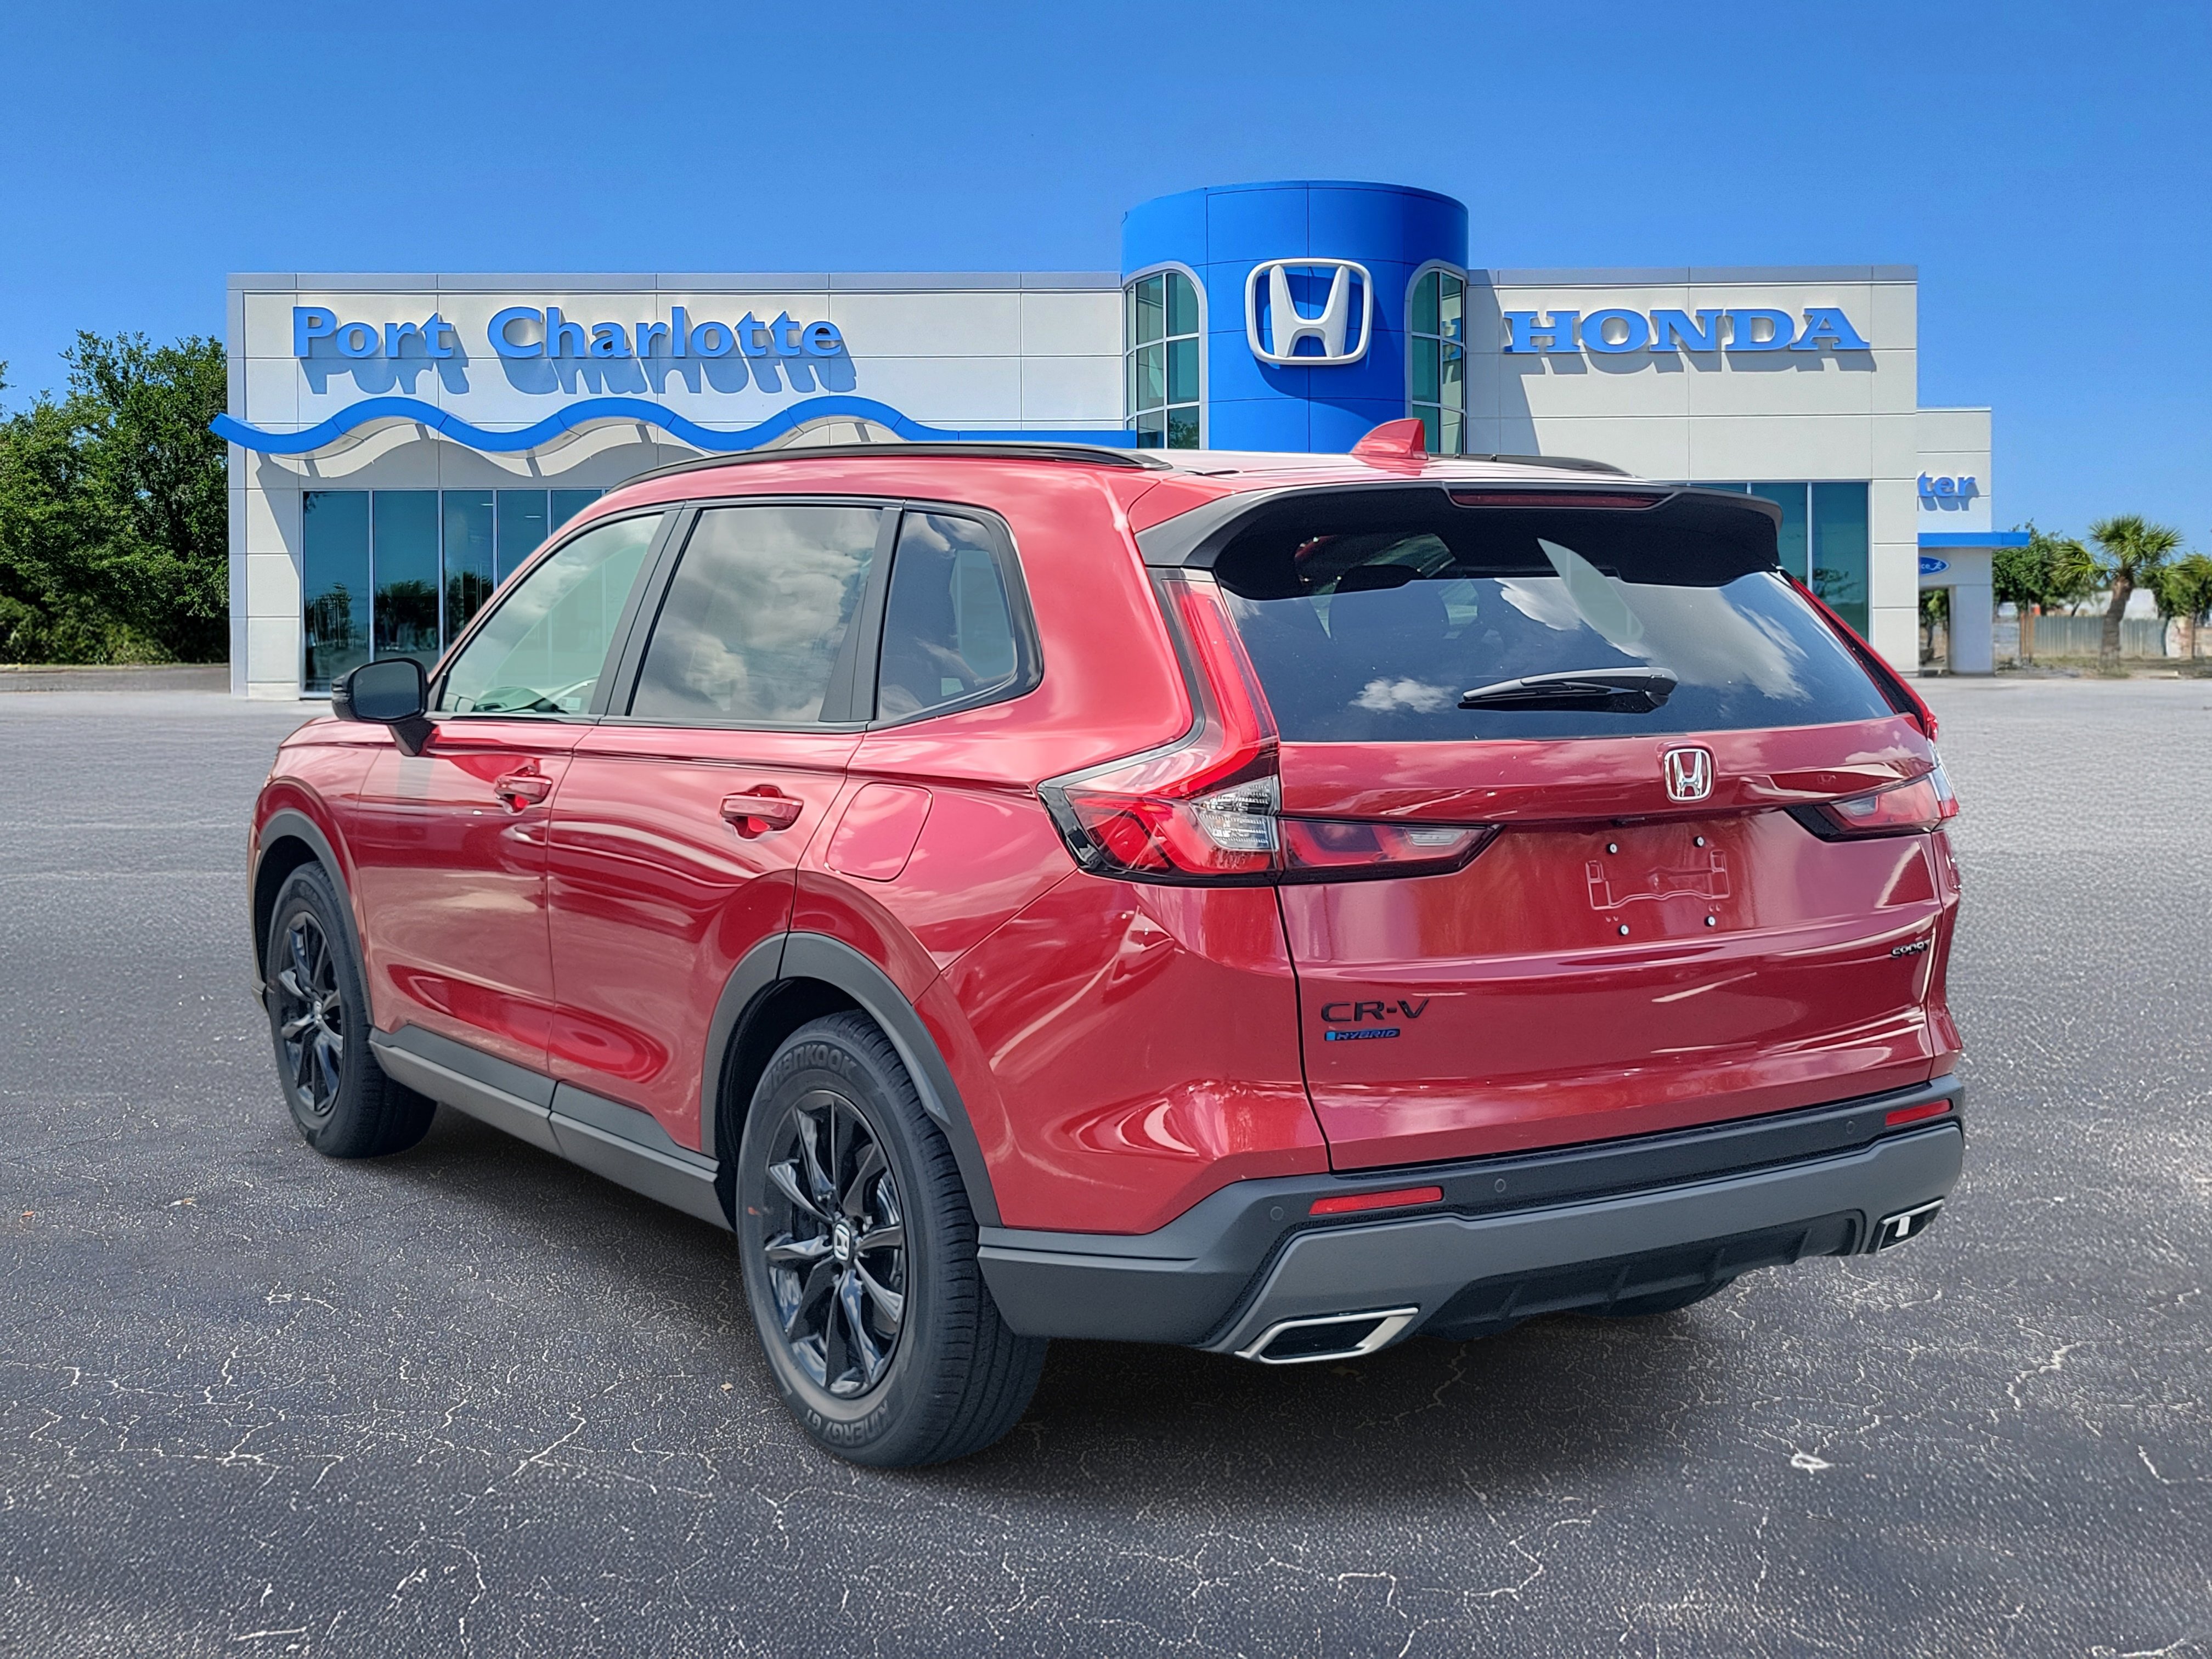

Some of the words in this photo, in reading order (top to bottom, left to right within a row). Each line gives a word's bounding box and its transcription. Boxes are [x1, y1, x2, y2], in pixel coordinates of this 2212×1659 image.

[293, 306, 454, 358] Port
[487, 306, 842, 358] Charlotte
[1503, 307, 1871, 353] HONDA
[1917, 471, 1976, 497] ter
[1321, 998, 1430, 1023] CR-V
[1336, 1029, 1398, 1040] HYBRID
